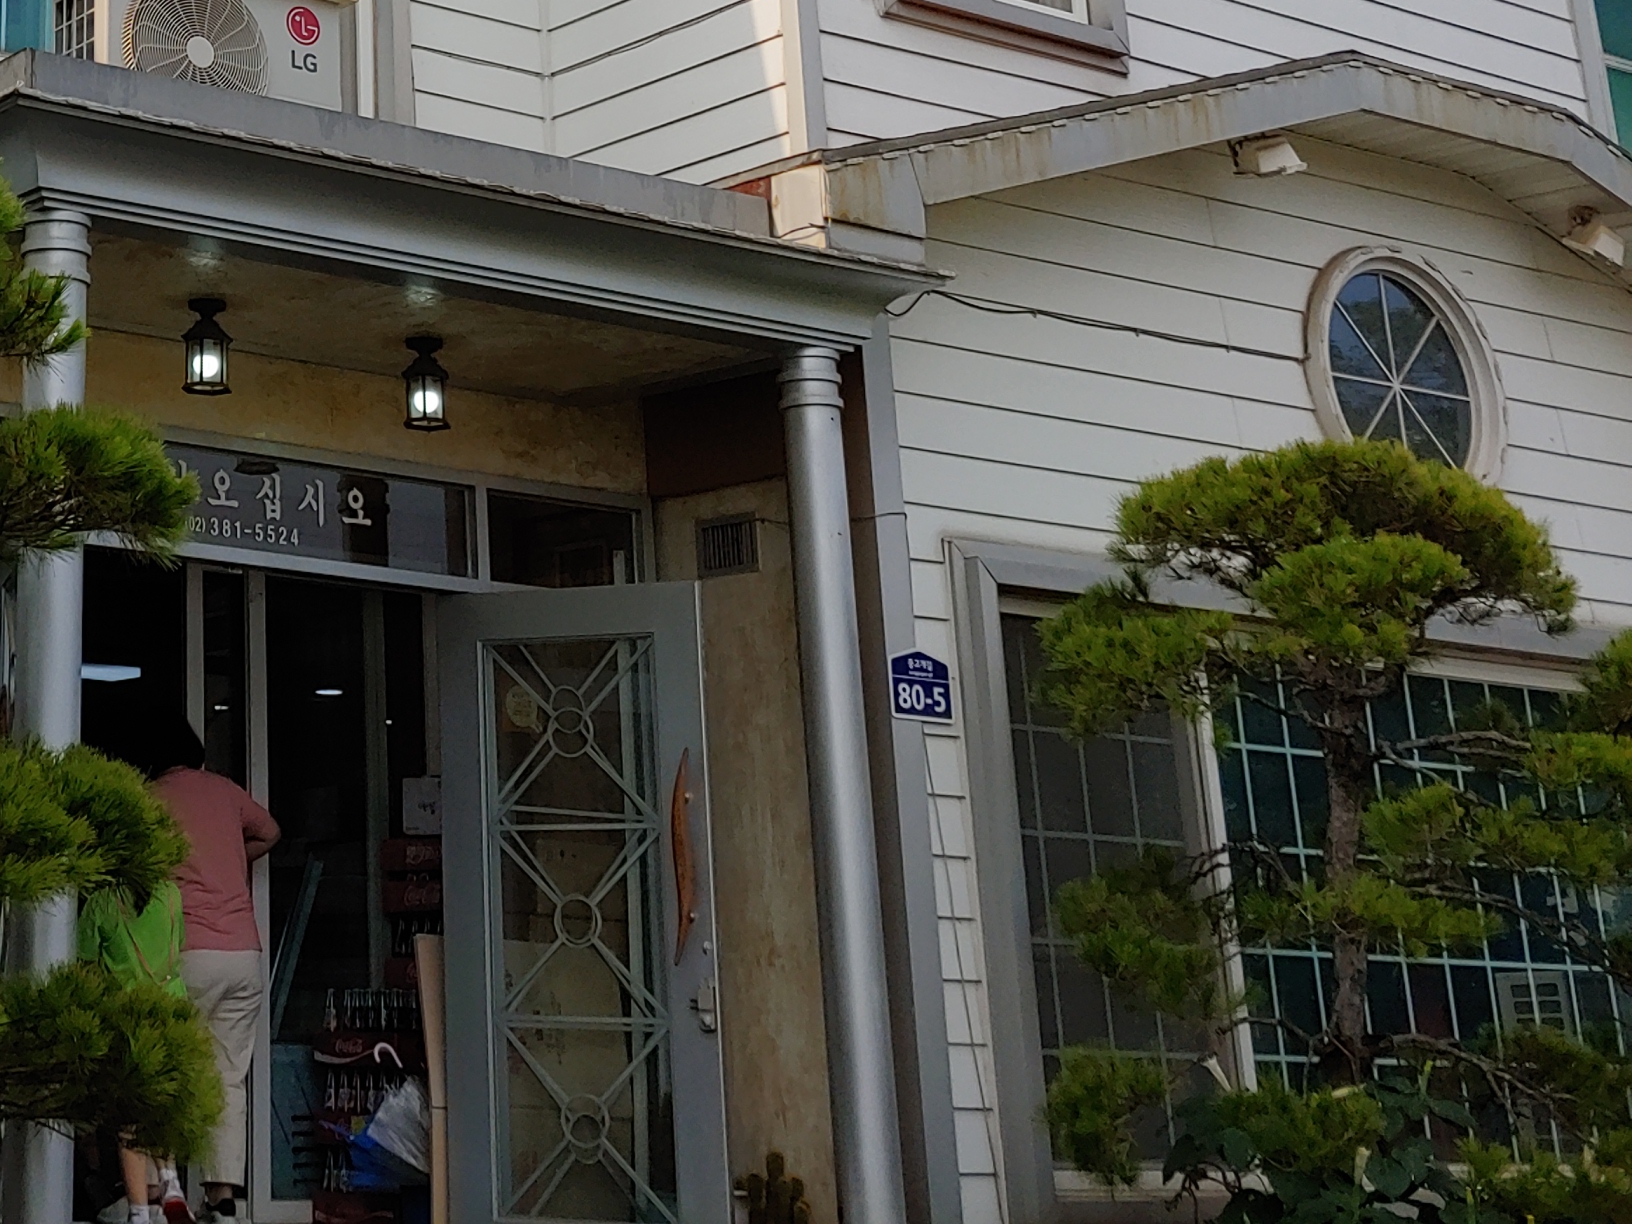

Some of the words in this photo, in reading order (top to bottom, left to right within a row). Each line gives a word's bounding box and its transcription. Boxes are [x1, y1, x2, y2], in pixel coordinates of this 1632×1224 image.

[291, 49, 318, 73] LG
[177, 459, 373, 528] 오십시오
[897, 682, 947, 713] 80-5
